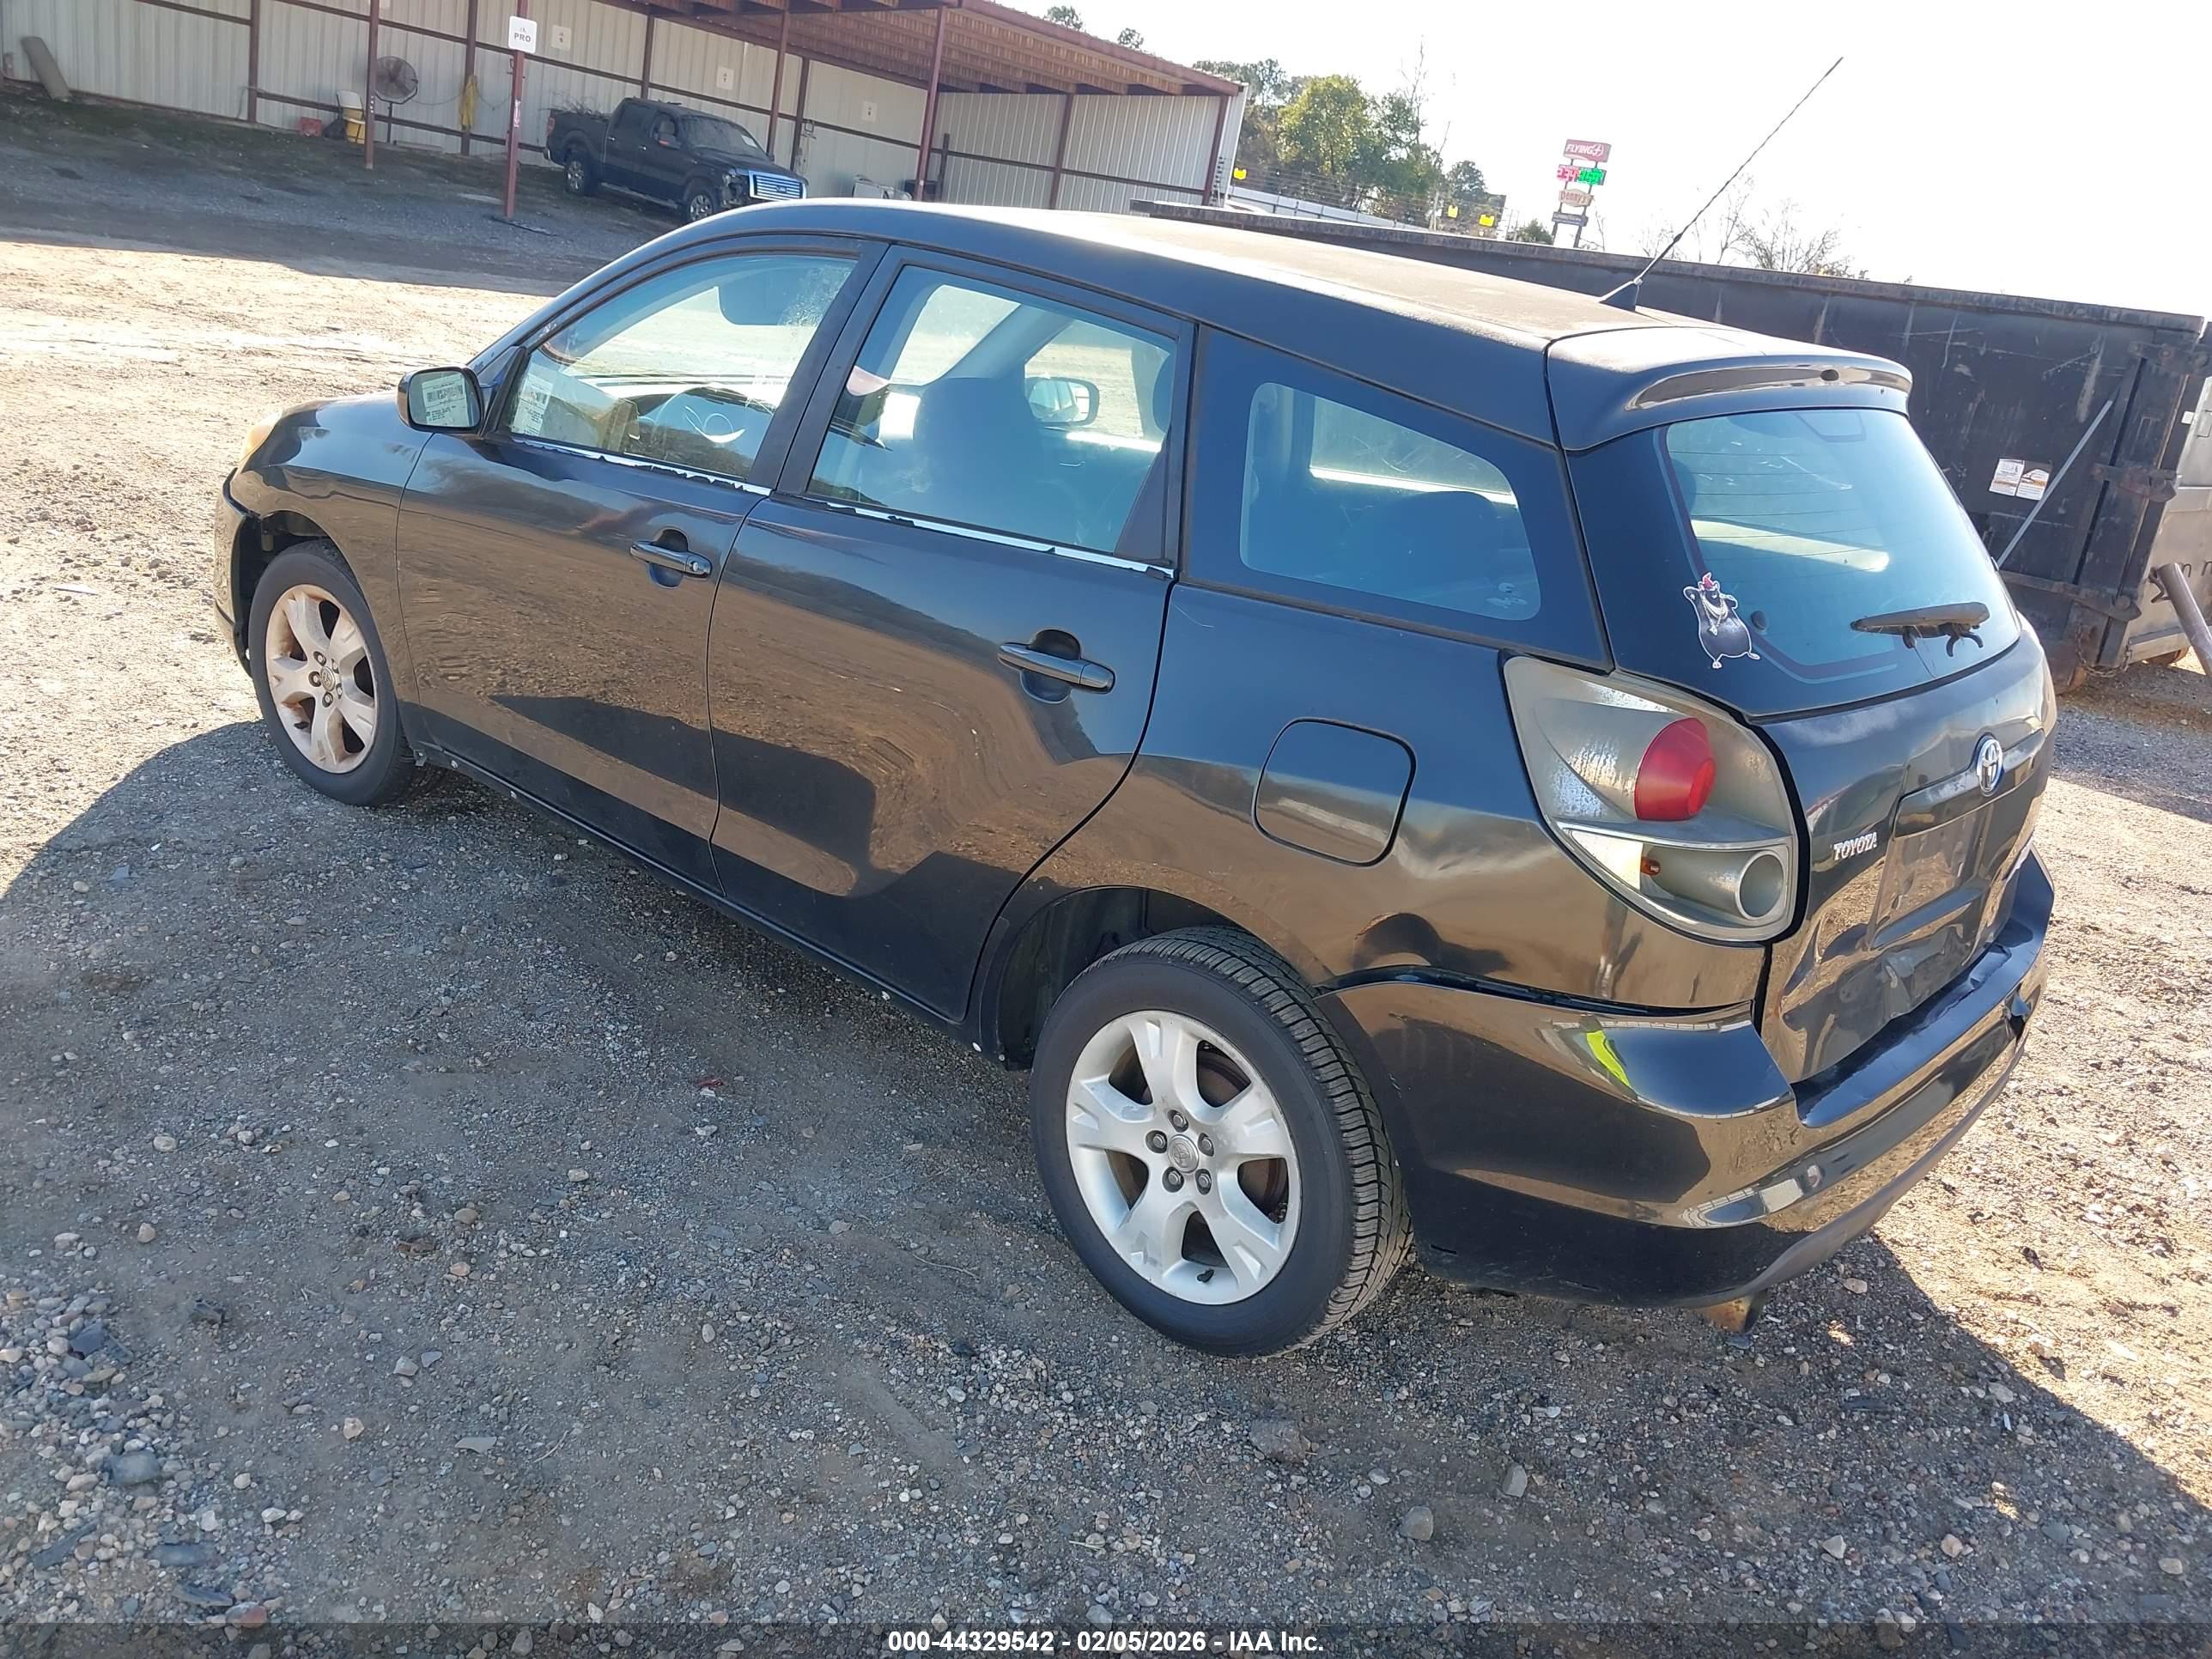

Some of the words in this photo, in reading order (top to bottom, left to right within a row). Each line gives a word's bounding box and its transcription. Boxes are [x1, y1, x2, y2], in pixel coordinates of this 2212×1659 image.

[514, 33, 532, 43] PRO
[1565, 143, 1595, 155] FLYING
[1833, 831, 1877, 860] TOYOTA
